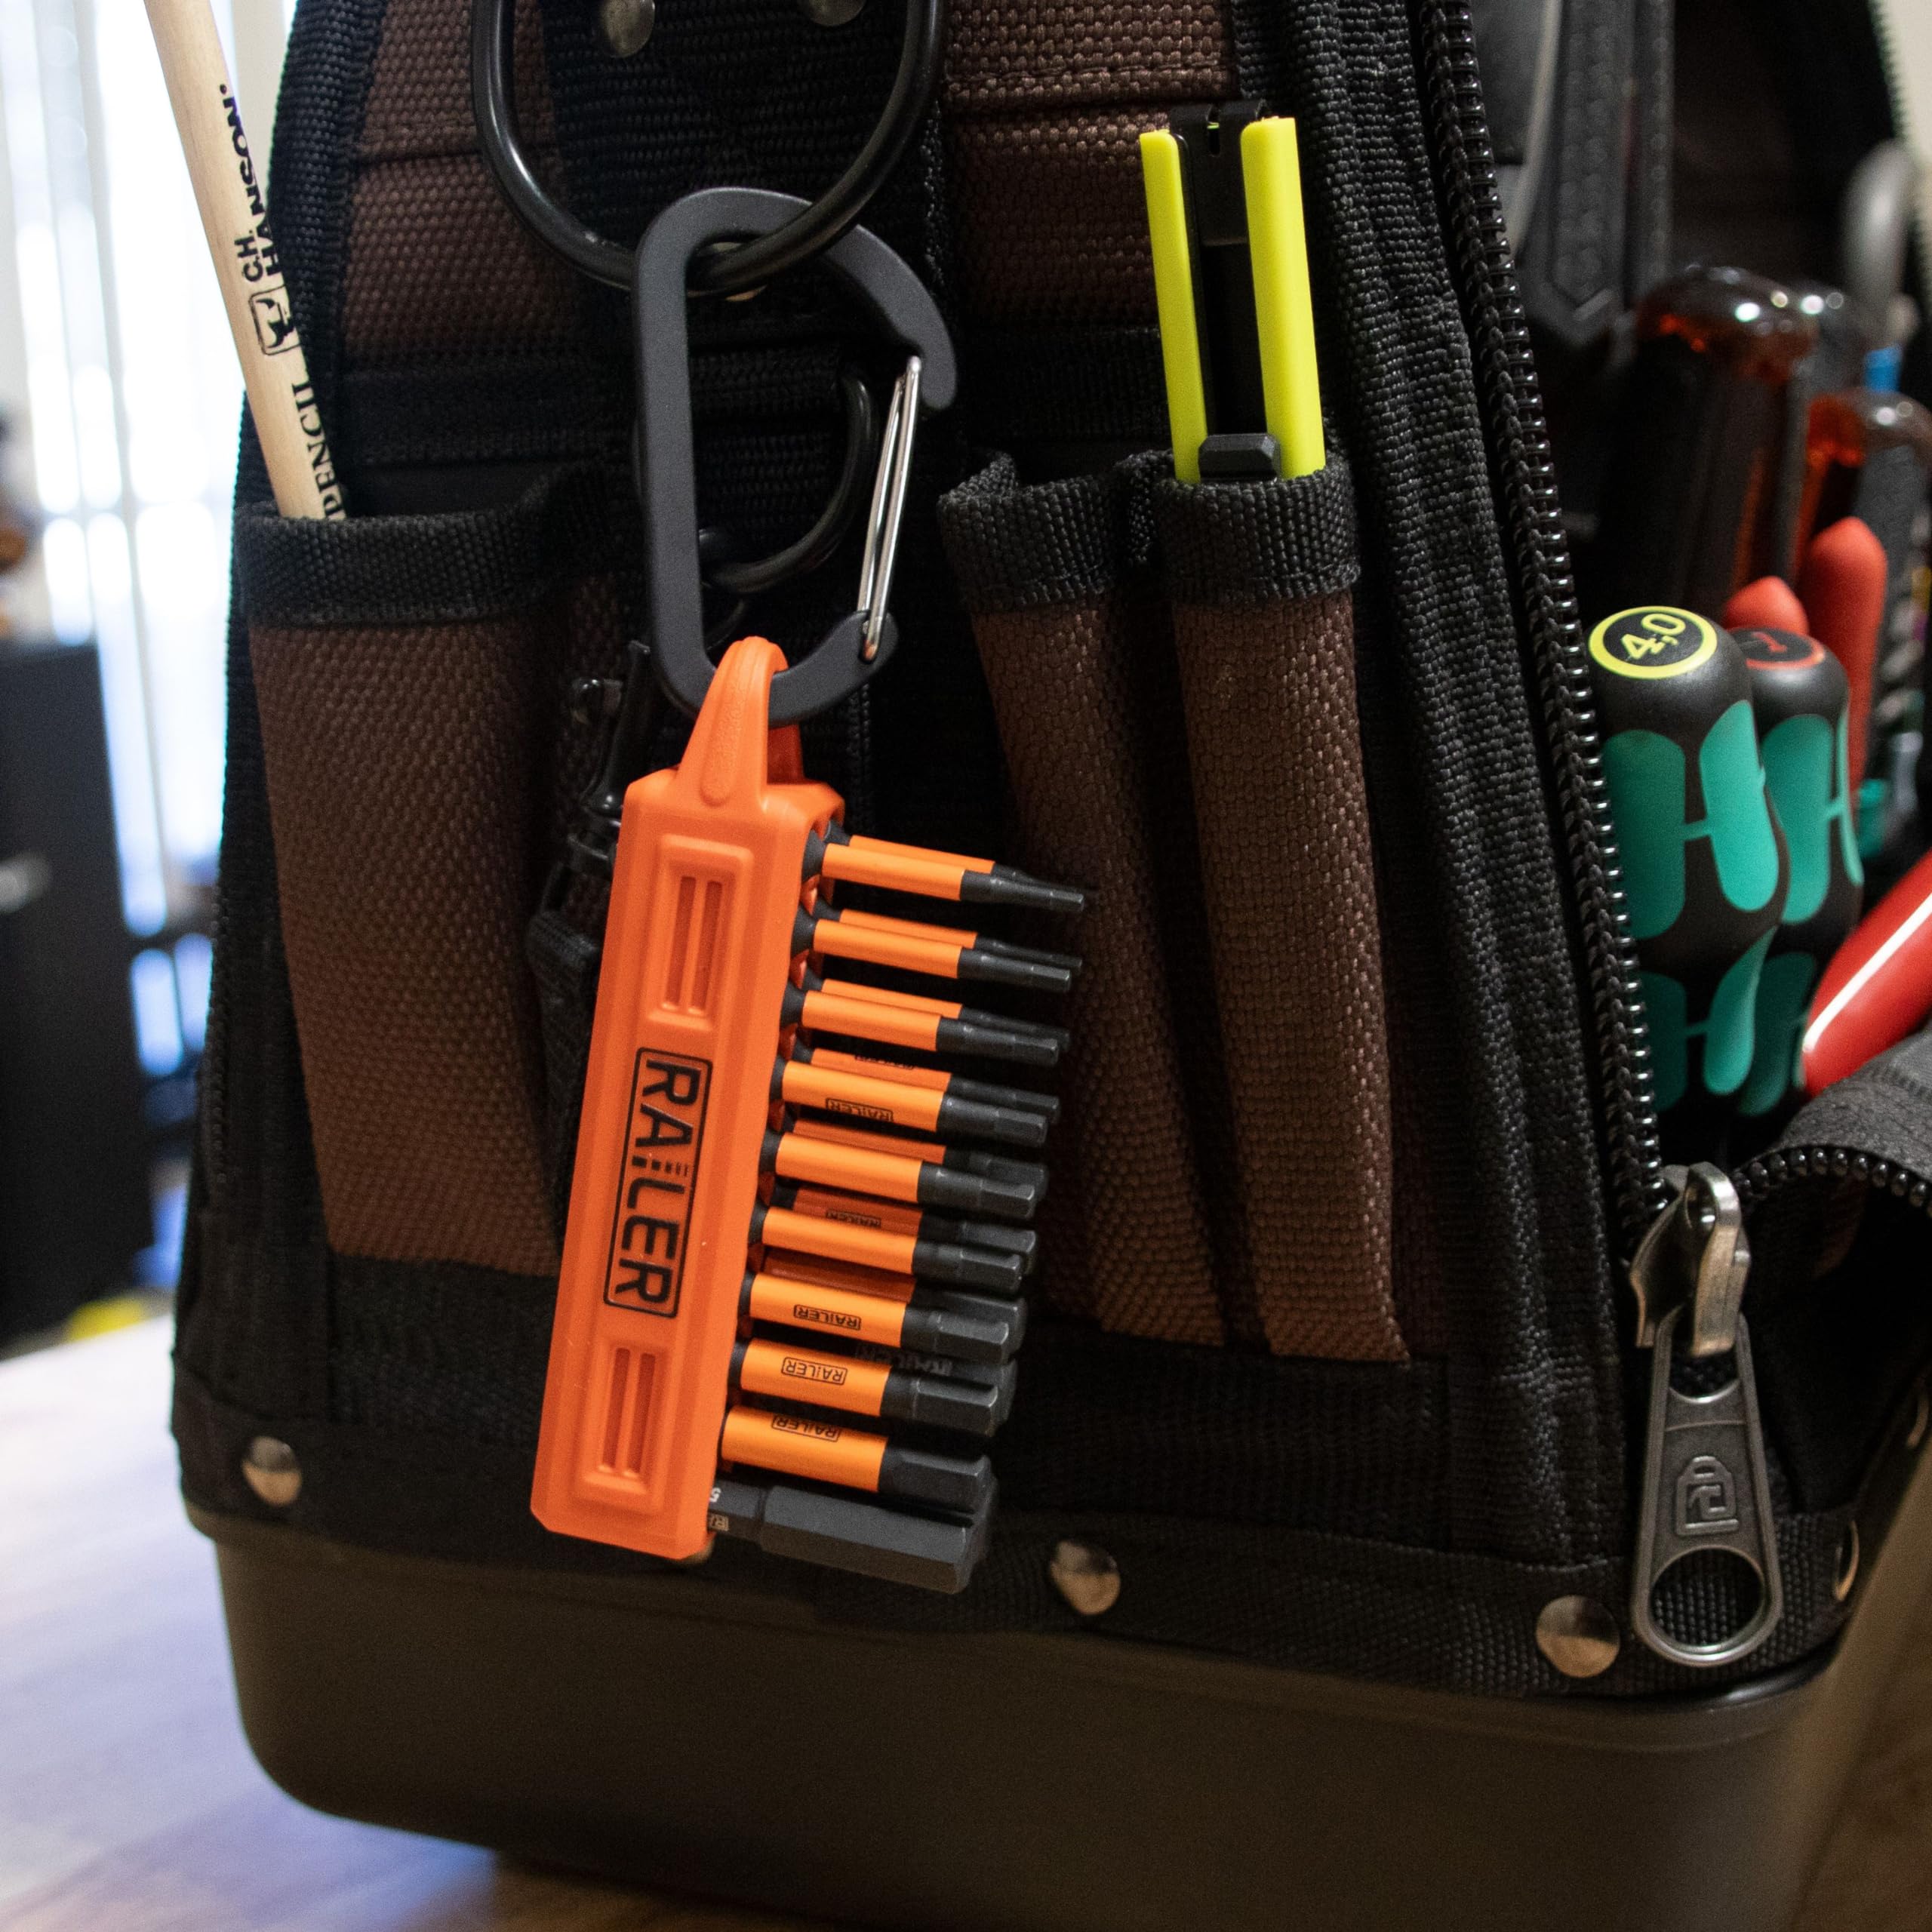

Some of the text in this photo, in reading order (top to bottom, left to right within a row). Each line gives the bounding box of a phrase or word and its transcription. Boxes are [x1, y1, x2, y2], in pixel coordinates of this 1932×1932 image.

[614, 1059, 701, 1303] RAILER
[797, 1306, 858, 1327] RAILER
[784, 1359, 844, 1383] RAILER
[775, 1416, 838, 1438] RAILER
